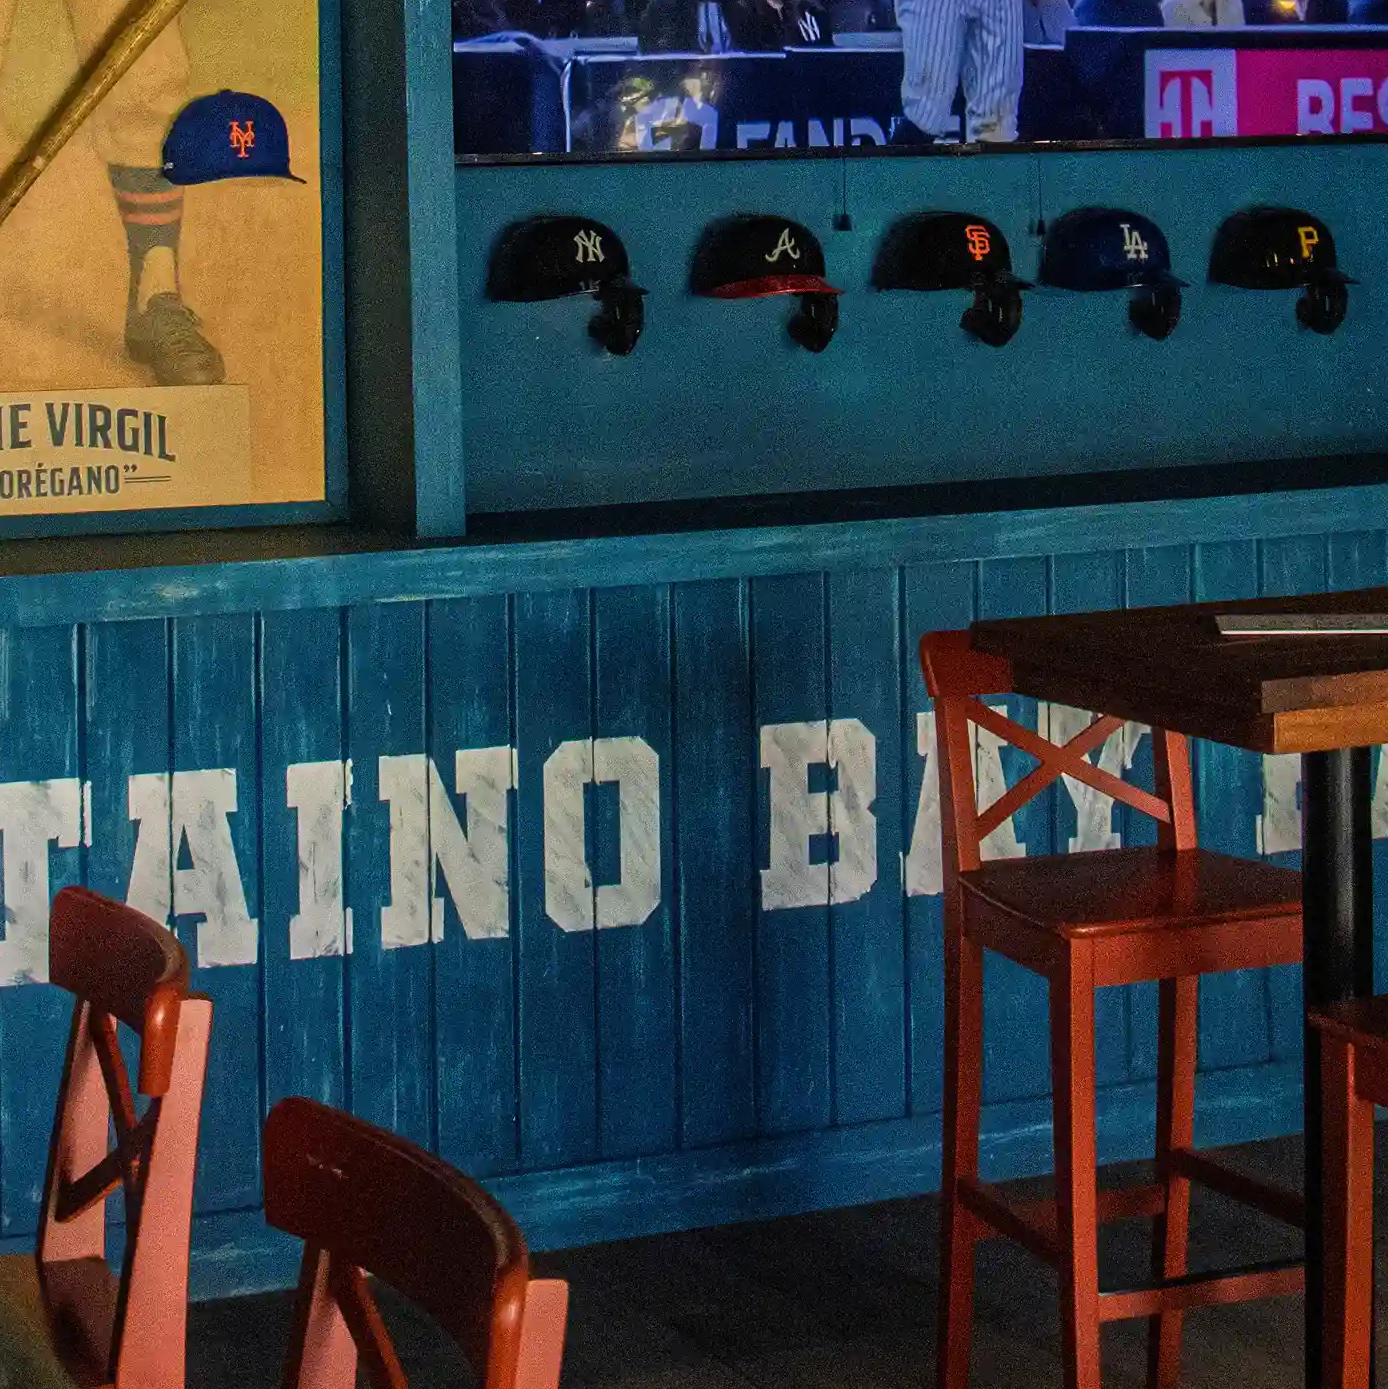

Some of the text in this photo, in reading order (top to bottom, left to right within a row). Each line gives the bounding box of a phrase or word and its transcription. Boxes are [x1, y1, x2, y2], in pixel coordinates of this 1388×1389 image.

[573, 229, 605, 263] NY
[764, 227, 801, 264] A
[965, 224, 992, 263] SF
[1120, 222, 1149, 261] LA
[1299, 225, 1320, 260] P
[45, 402, 176, 462] VIRGIL
[760, 701, 1153, 910] BAY
